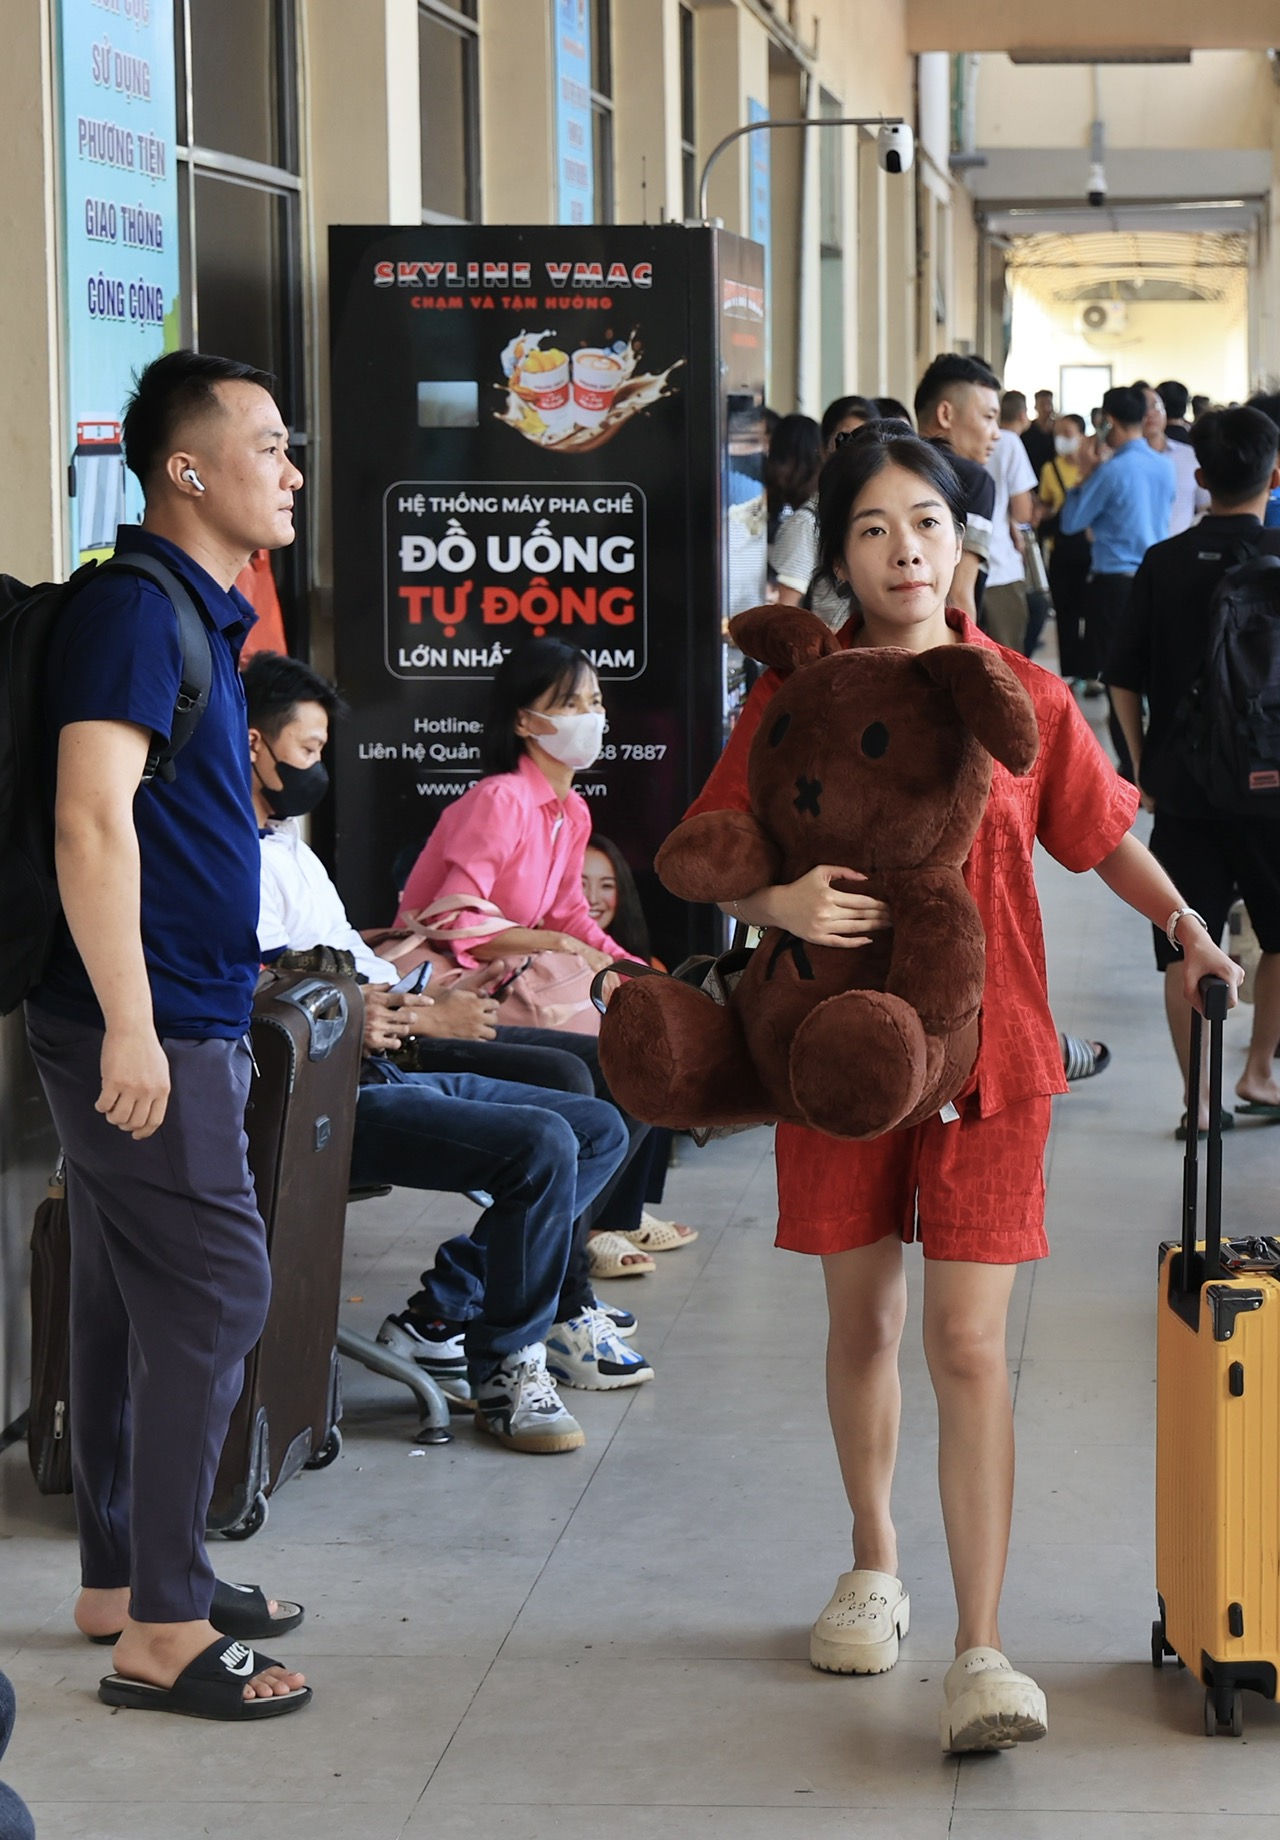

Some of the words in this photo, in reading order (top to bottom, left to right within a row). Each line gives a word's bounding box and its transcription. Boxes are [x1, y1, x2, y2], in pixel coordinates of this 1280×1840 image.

[92, 34, 112, 86] SỬ
[114, 51, 151, 100] DỤNG
[77, 117, 134, 168] PHƯƠNG
[137, 132, 166, 183] TIỆN
[85, 198, 117, 240] GIAO
[121, 203, 164, 250] THÔNG
[373, 261, 532, 288] SKYLINE
[545, 262, 653, 289] VMAC
[87, 271, 126, 318] CÔNG
[129, 277, 164, 328] CỘNG
[398, 493, 426, 517] HỆ
[429, 491, 498, 513] THỐNG
[502, 493, 545, 513] MÁY
[549, 497, 590, 513] PHA
[593, 492, 634, 514] CHẾ
[398, 517, 477, 574] ĐỒ
[486, 517, 636, 574] UỐNG
[398, 579, 474, 638] TỰ
[480, 576, 636, 638] ĐỘNG
[398, 644, 448, 668] LỚN
[413, 717, 484, 733] Hotline:
[358, 742, 398, 759] Liên
[401, 742, 426, 763] hệ
[620, 744, 668, 760] 7887
[220, 1641, 250, 1669] NIKE
